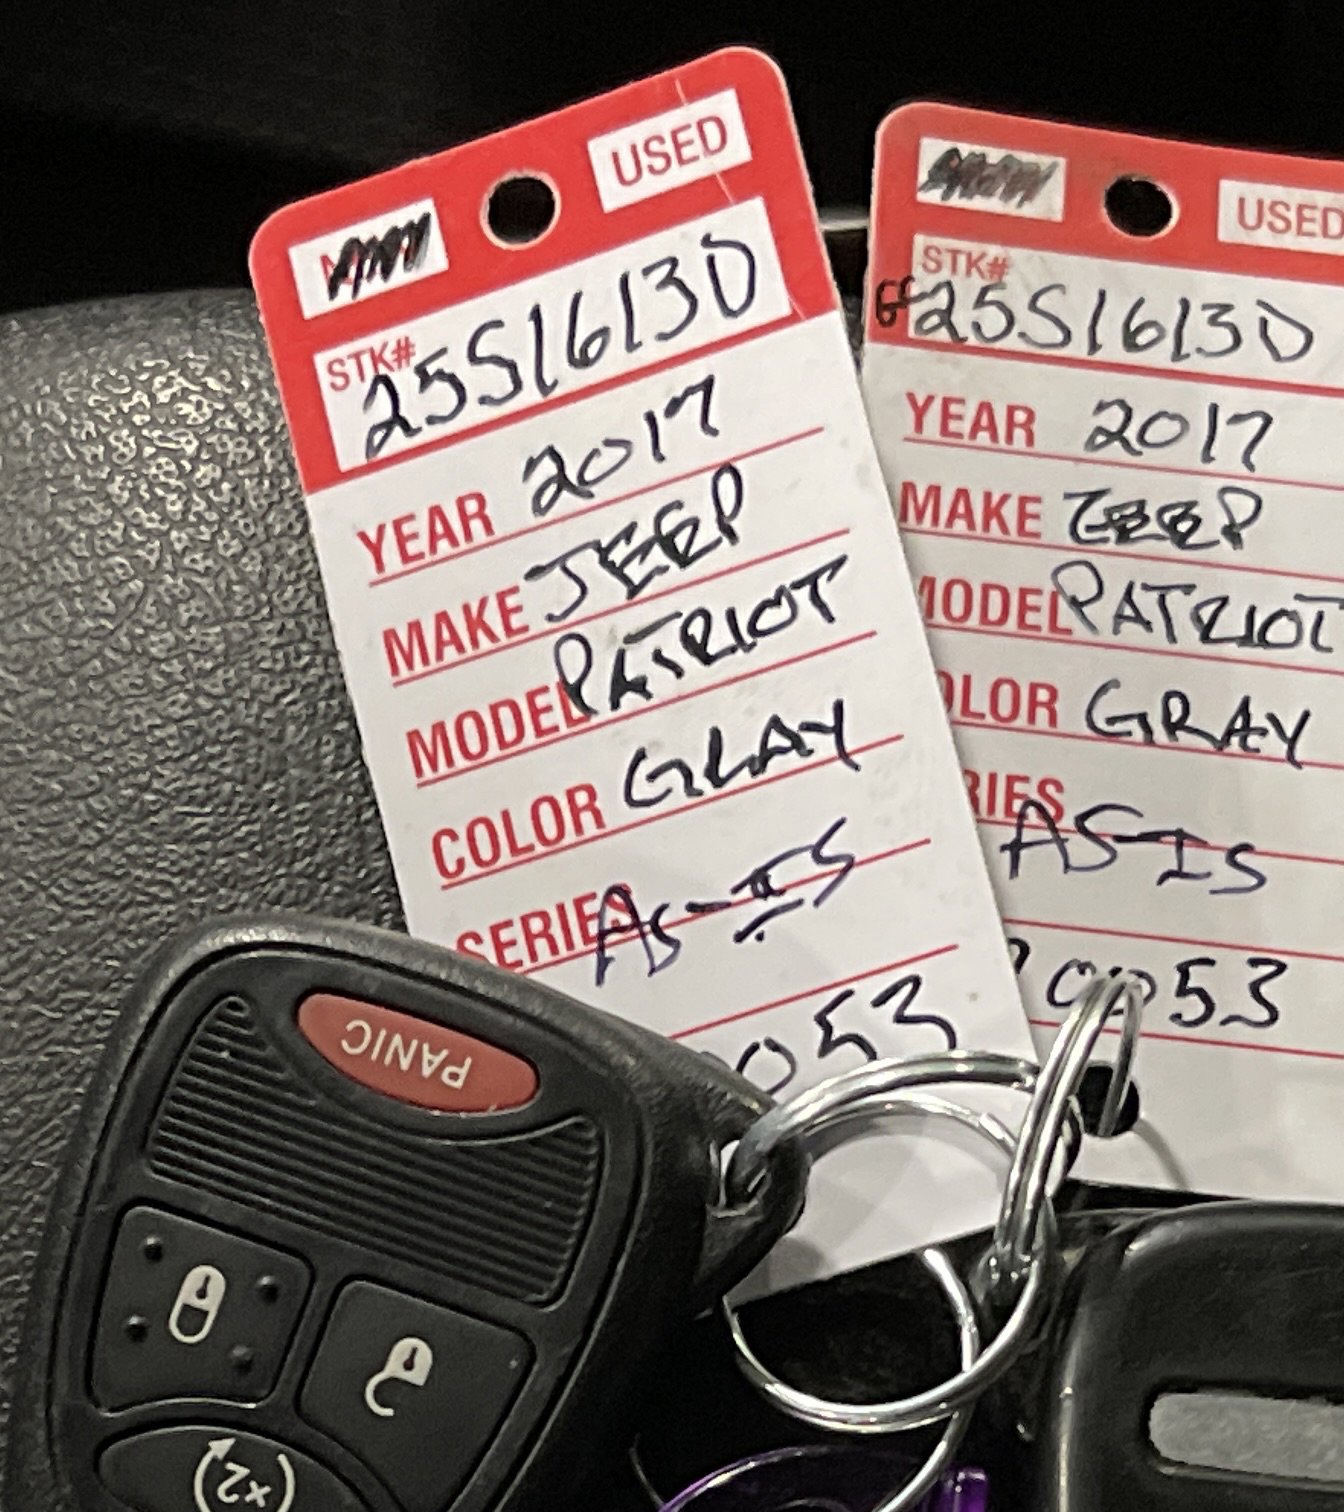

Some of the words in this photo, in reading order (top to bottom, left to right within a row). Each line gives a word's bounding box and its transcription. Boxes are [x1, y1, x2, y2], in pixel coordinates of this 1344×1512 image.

[612, 115, 729, 188] USED
[921, 244, 1011, 284] STK#
[326, 335, 416, 392] STK#
[522, 373, 720, 518] 2017
[904, 390, 1038, 449] YEAR
[1083, 397, 1274, 473] 2017
[357, 490, 496, 575] YEAR
[524, 462, 744, 624] JEEP
[899, 480, 1044, 540] MAKE
[382, 584, 531, 679] MAKE
[553, 553, 848, 717] PATRIOT
[406, 679, 592, 779] MODEL
[1084, 678, 1311, 770] GRAY
[431, 781, 607, 882] COLOR
[340, 1018, 473, 1090] PANIC
[735, 973, 957, 1096] 053
